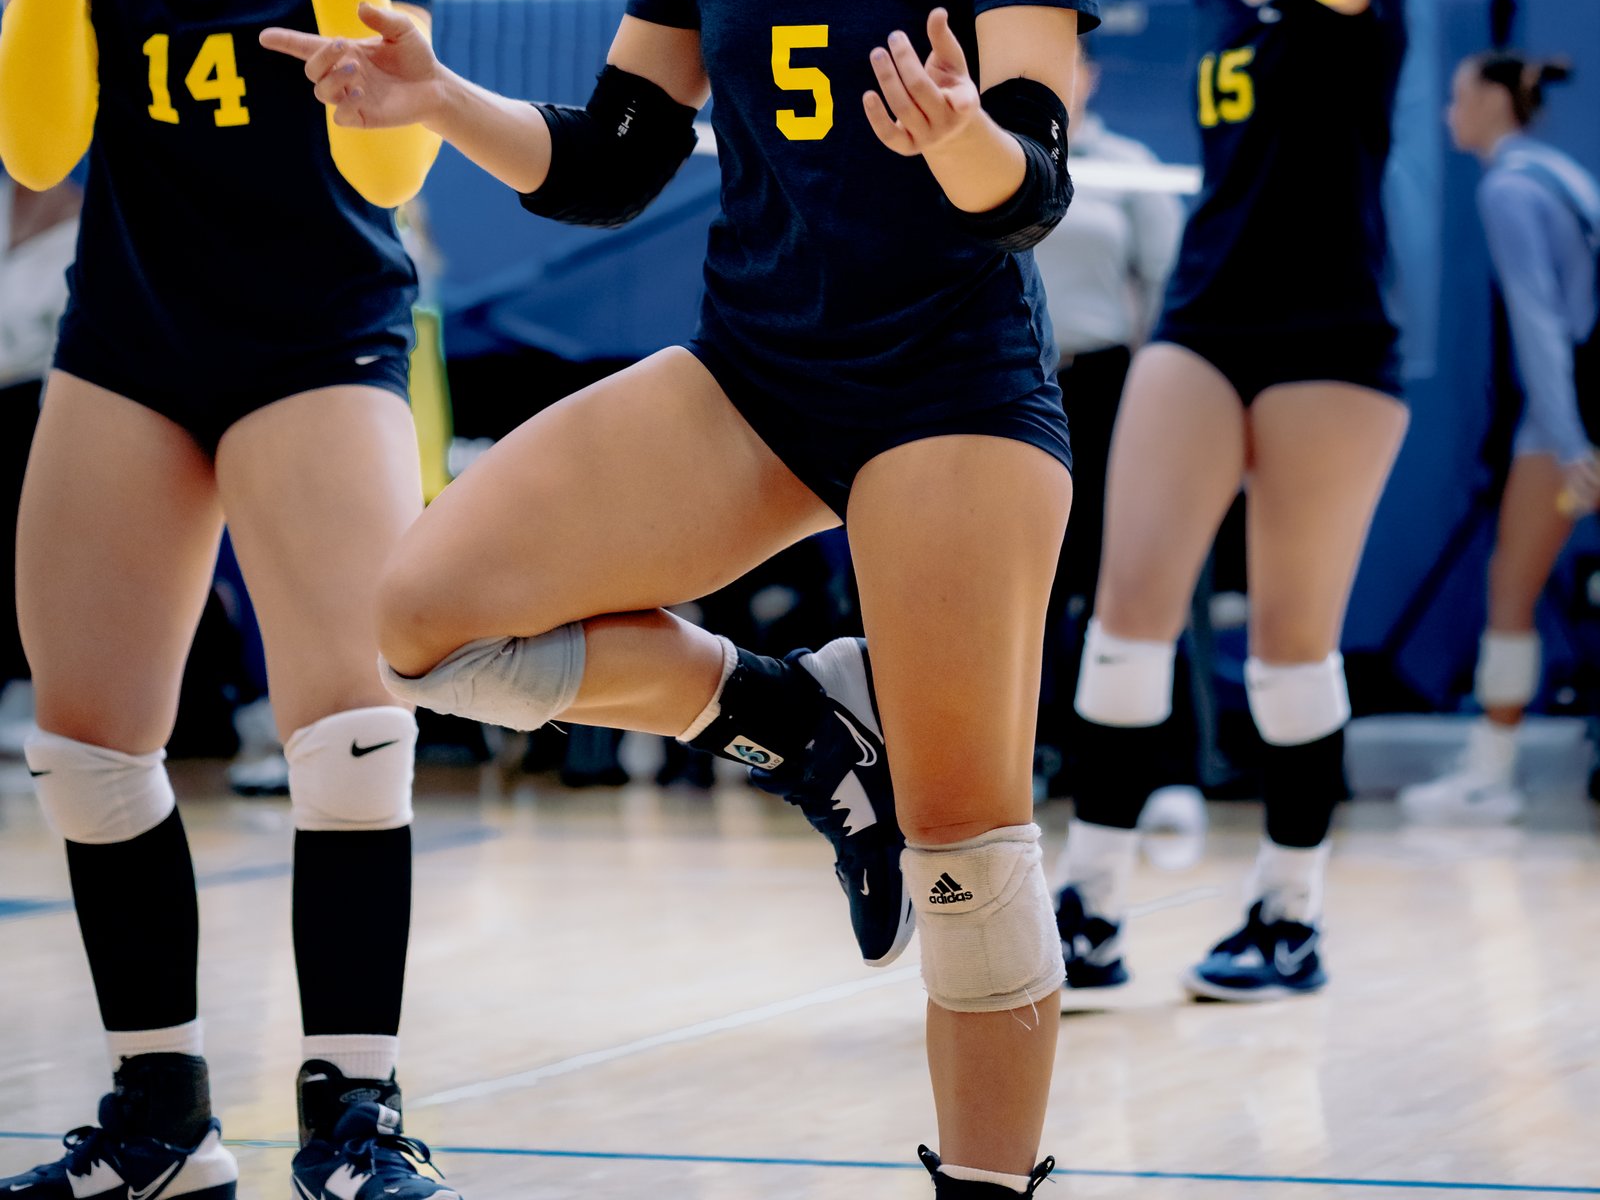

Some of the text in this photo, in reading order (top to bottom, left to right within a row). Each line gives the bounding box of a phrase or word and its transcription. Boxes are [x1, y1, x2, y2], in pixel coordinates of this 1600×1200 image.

[142, 32, 250, 127] 14
[771, 24, 834, 141] 5
[1198, 46, 1255, 128] 15
[929, 889, 974, 905] adidas
